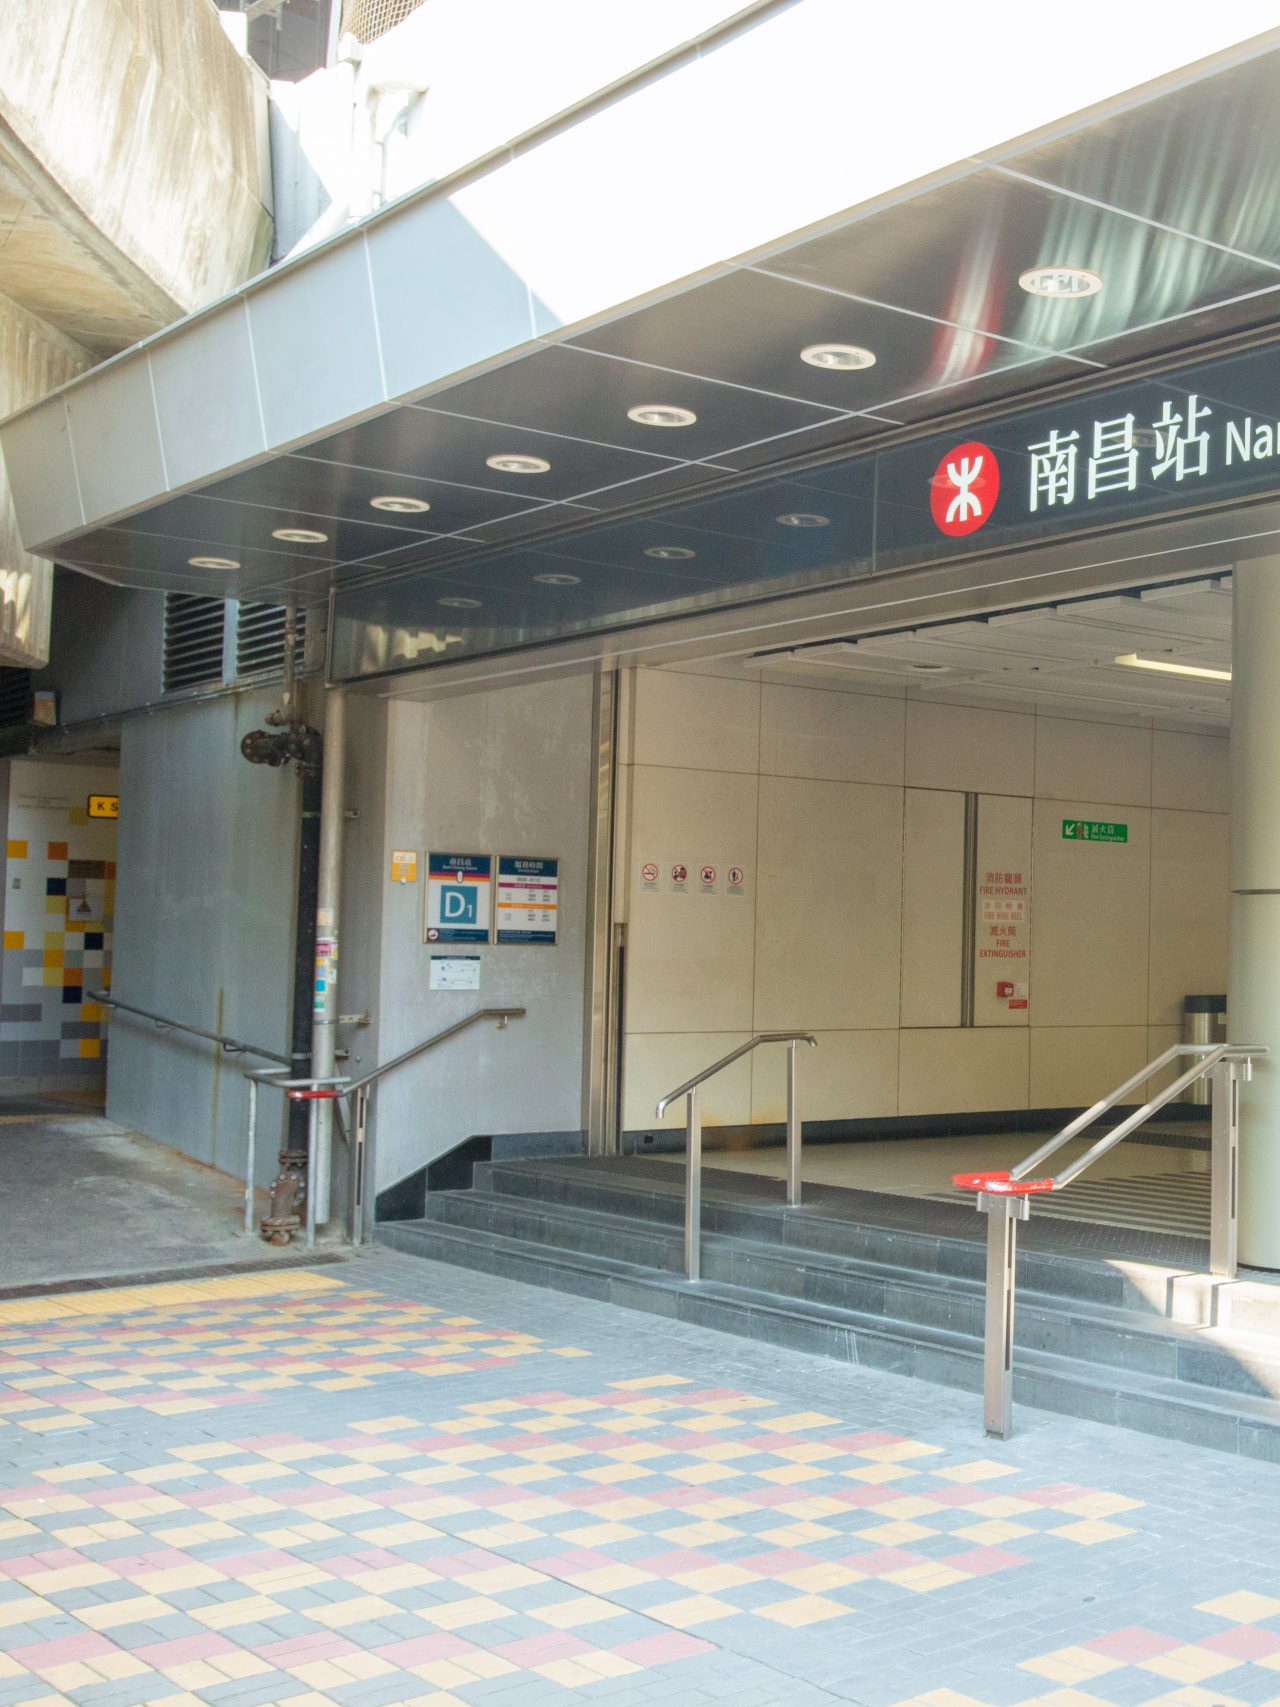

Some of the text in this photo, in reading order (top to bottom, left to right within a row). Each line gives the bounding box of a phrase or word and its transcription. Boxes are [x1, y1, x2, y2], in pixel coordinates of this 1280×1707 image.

[1028, 394, 1212, 513] 南昌站
[979, 886, 1027, 896] FIRE HYDRANT
[996, 939, 1010, 947] FIRE
[979, 949, 1026, 959] EXTINGUISHER
